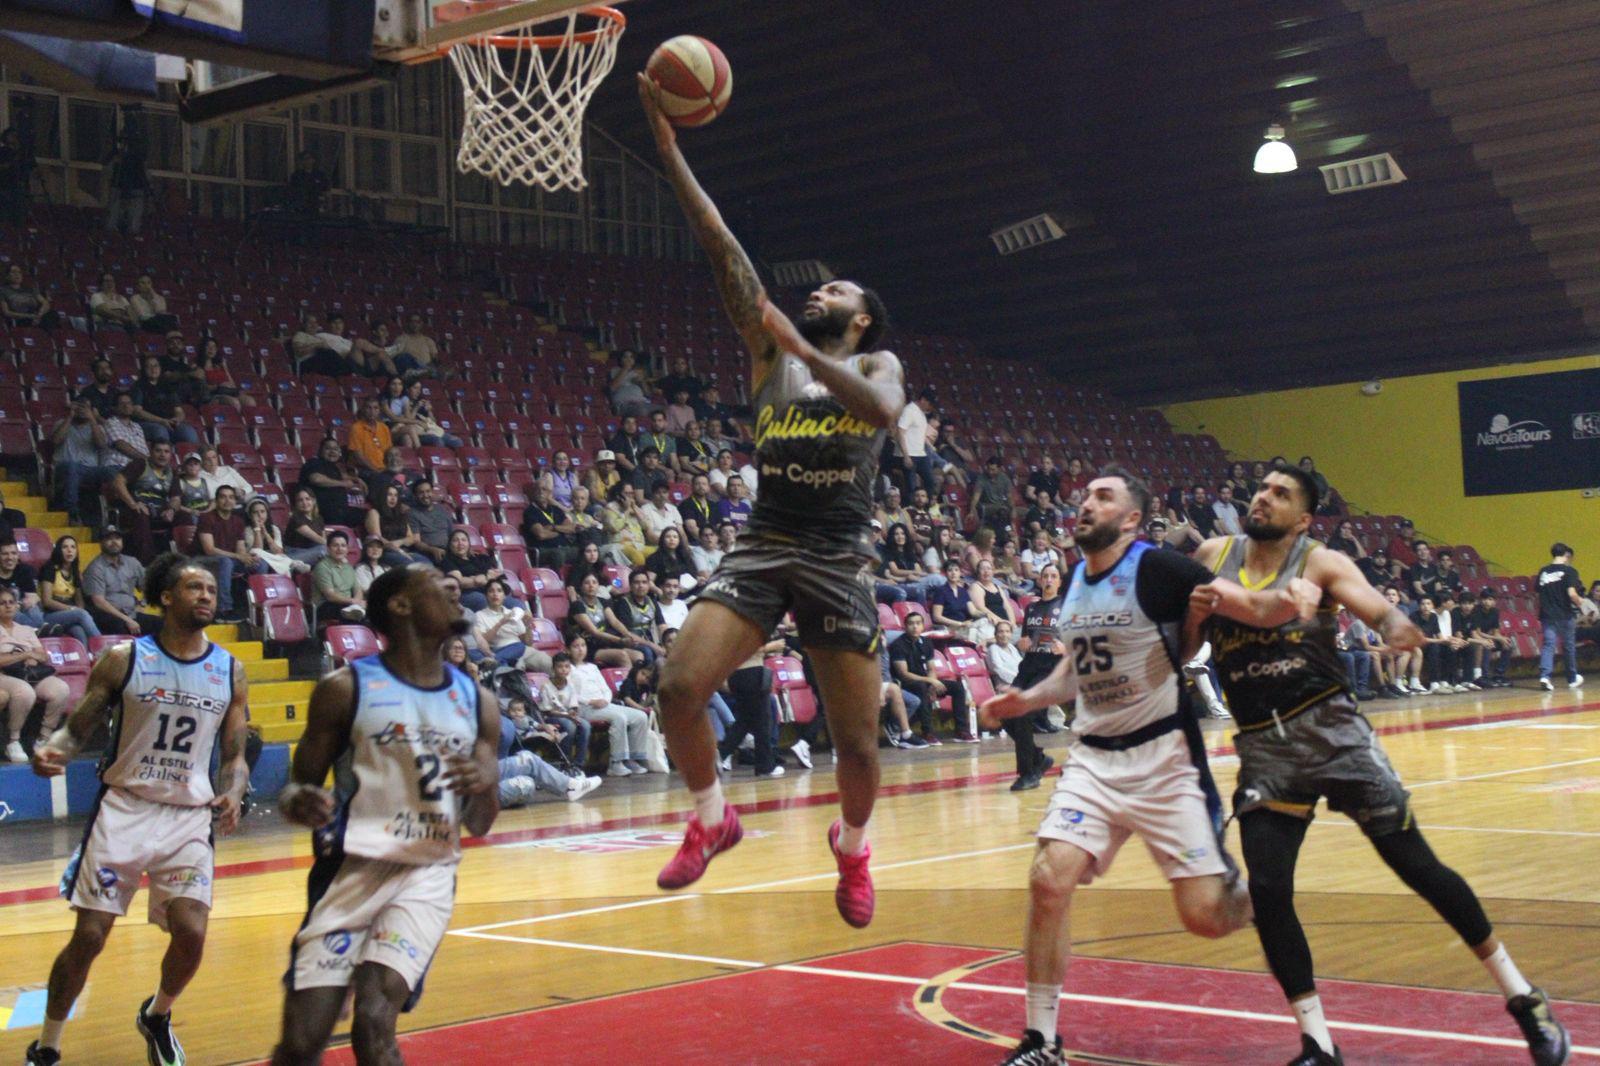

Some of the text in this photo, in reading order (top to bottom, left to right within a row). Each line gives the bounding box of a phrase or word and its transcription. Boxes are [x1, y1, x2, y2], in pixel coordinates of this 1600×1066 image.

[1072, 635, 1113, 676] 25
[138, 686, 226, 715] ASTROS
[153, 713, 197, 753] 12
[140, 755, 156, 765] AL
